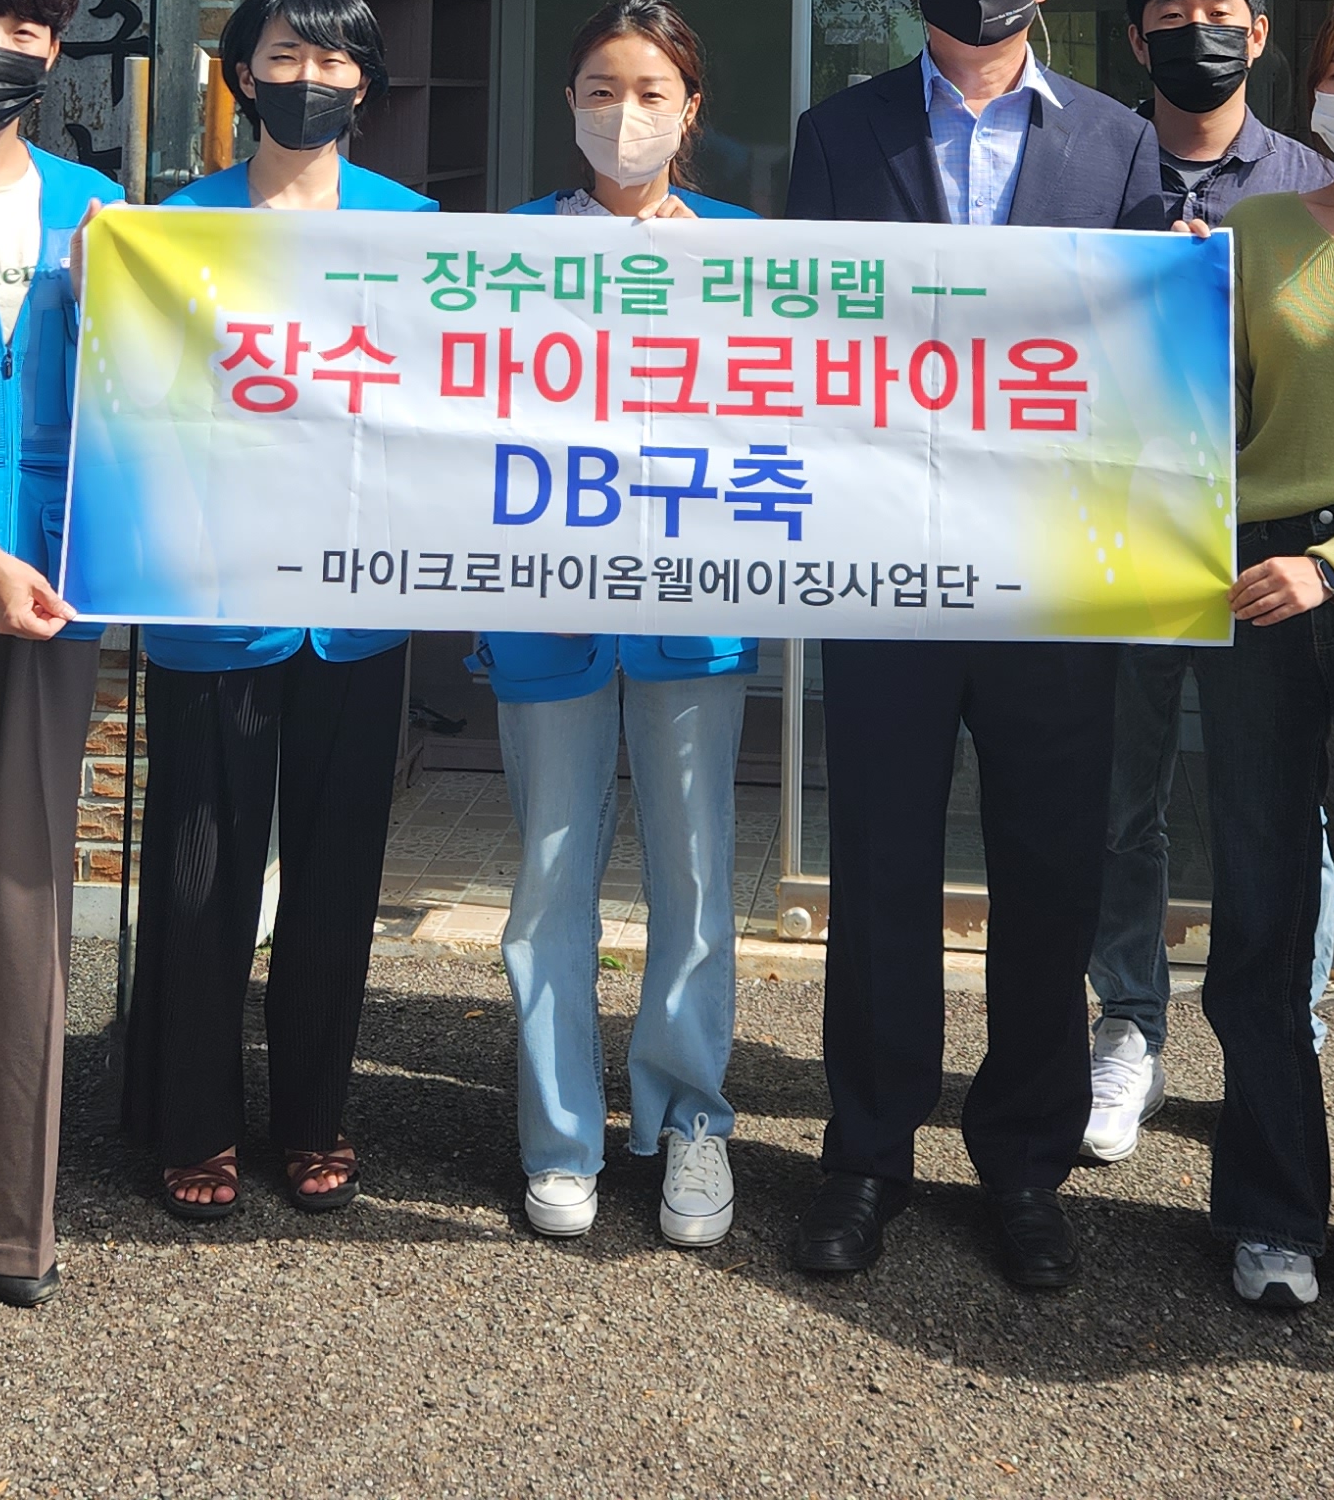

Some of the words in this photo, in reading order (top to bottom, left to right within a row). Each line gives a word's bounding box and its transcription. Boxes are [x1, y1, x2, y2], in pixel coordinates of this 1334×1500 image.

[422, 250, 675, 316] 장수마을
[702, 256, 885, 319] 리빙랩
[220, 321, 401, 414] 장수
[440, 327, 1088, 432] 마이크로바이옴
[492, 443, 813, 542] DB구축
[322, 548, 980, 609] 마이크로바이옴웰에이징사업단
